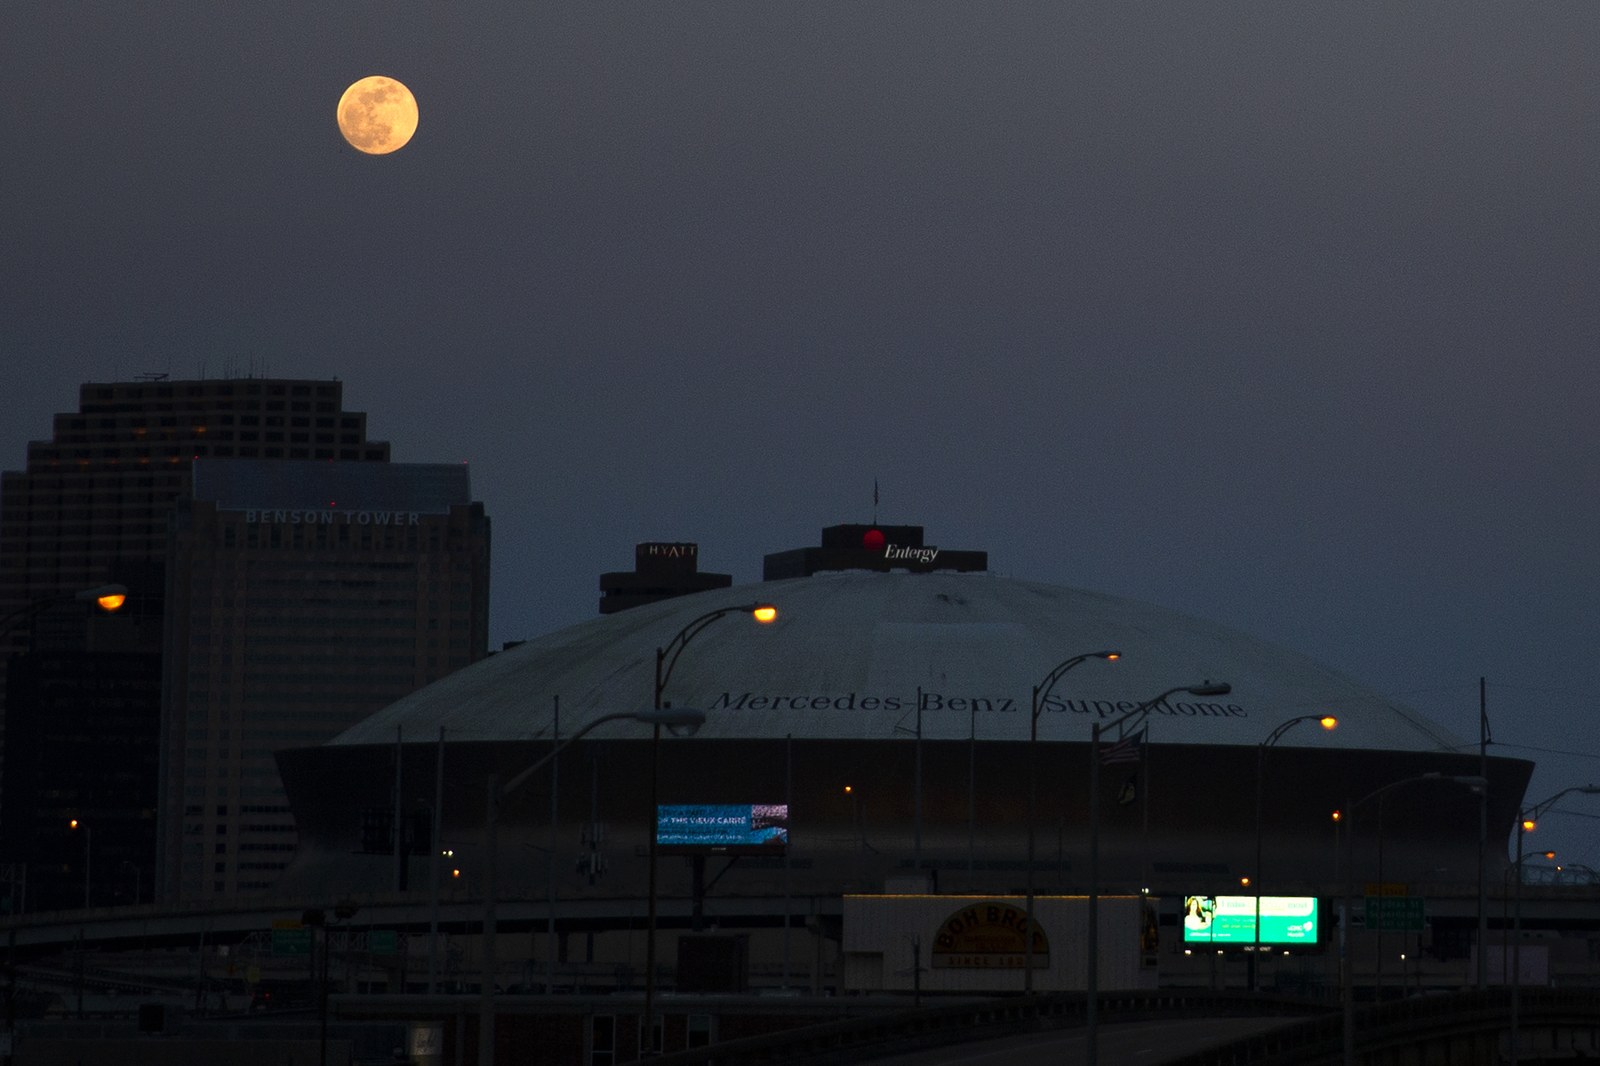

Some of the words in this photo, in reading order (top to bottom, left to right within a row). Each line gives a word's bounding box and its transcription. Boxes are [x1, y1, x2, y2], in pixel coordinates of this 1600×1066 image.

[245, 509, 335, 525] BENSON
[343, 511, 421, 526] TOWER
[648, 544, 697, 558] HYATT
[883, 543, 939, 564] Entergy
[938, 907, 980, 948] BOH
[949, 956, 991, 966] SINCE
